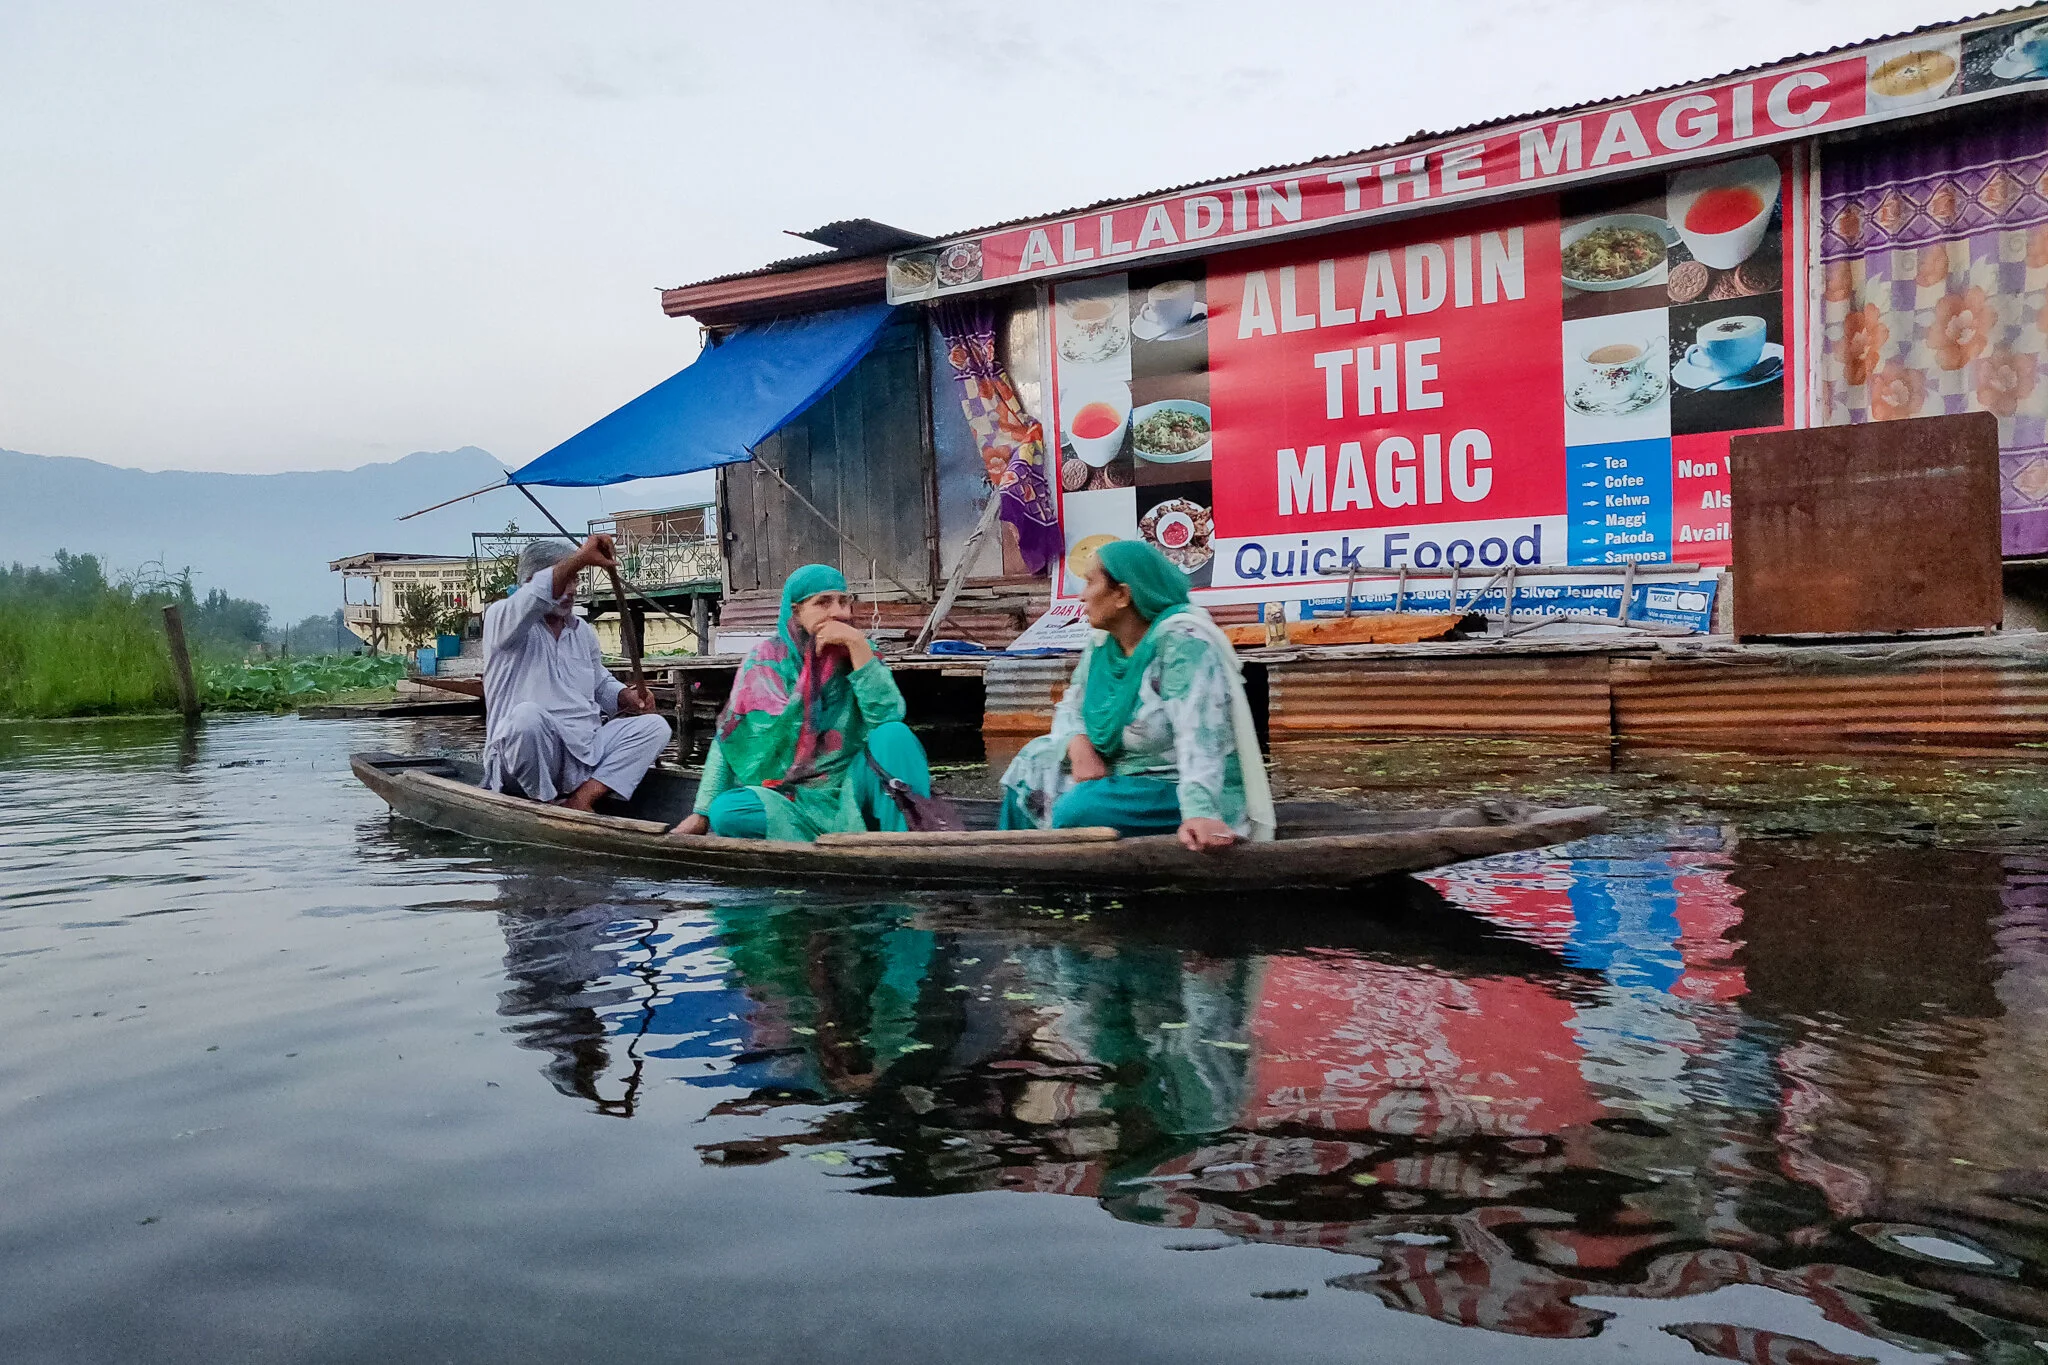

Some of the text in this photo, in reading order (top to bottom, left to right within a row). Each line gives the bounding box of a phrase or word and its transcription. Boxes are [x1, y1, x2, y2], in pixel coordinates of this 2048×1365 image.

[1018, 71, 1831, 273] ALLADIN THE MAGIC
[1238, 226, 1526, 340] ALLADIN
[1314, 337, 1444, 420] THE
[1603, 456, 1628, 470] Tea
[1678, 459, 1719, 479] Non
[1277, 428, 1493, 517] MAGIC
[1604, 474, 1645, 489] Cofee
[1605, 493, 1650, 508] Kehwa
[1605, 511, 1647, 528] Maggi
[1604, 530, 1655, 545] Pakoda
[1679, 522, 1733, 543] Avail
[1234, 523, 1543, 581] Quick Foood
[1604, 550, 1667, 564] Samoosa
[1520, 586, 1561, 599] Silver
[1566, 586, 1640, 602] Jewelley
[1050, 604, 1075, 617] DAR
